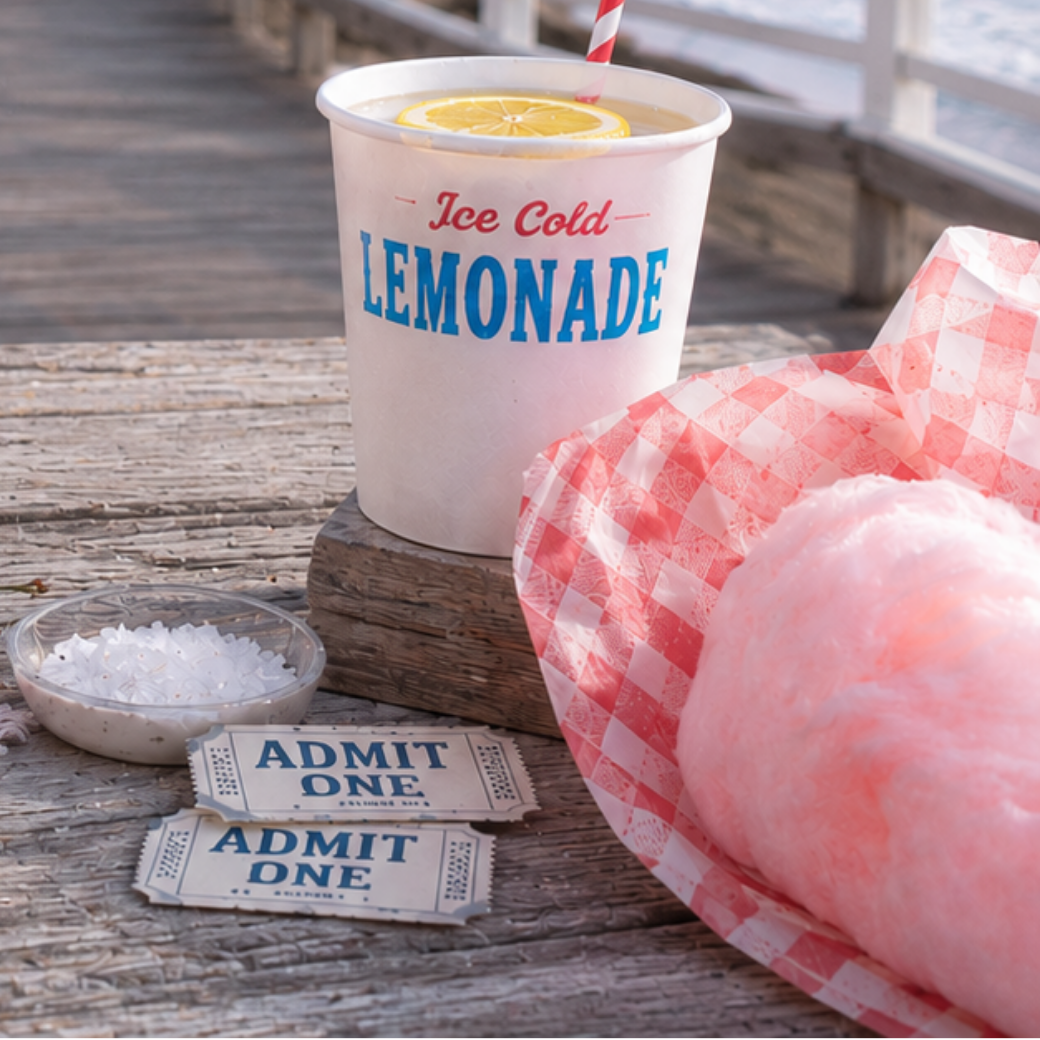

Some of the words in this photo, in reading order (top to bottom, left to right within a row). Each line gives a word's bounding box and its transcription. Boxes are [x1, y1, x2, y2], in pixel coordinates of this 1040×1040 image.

[428, 191, 500, 233] Ice
[514, 199, 613, 237] Cold
[359, 230, 669, 343] LEMONADE
[255, 739, 449, 769] ADMIT
[301, 774, 425, 798] ONE
[209, 826, 418, 863] ADMIT
[247, 861, 372, 890] ONE
